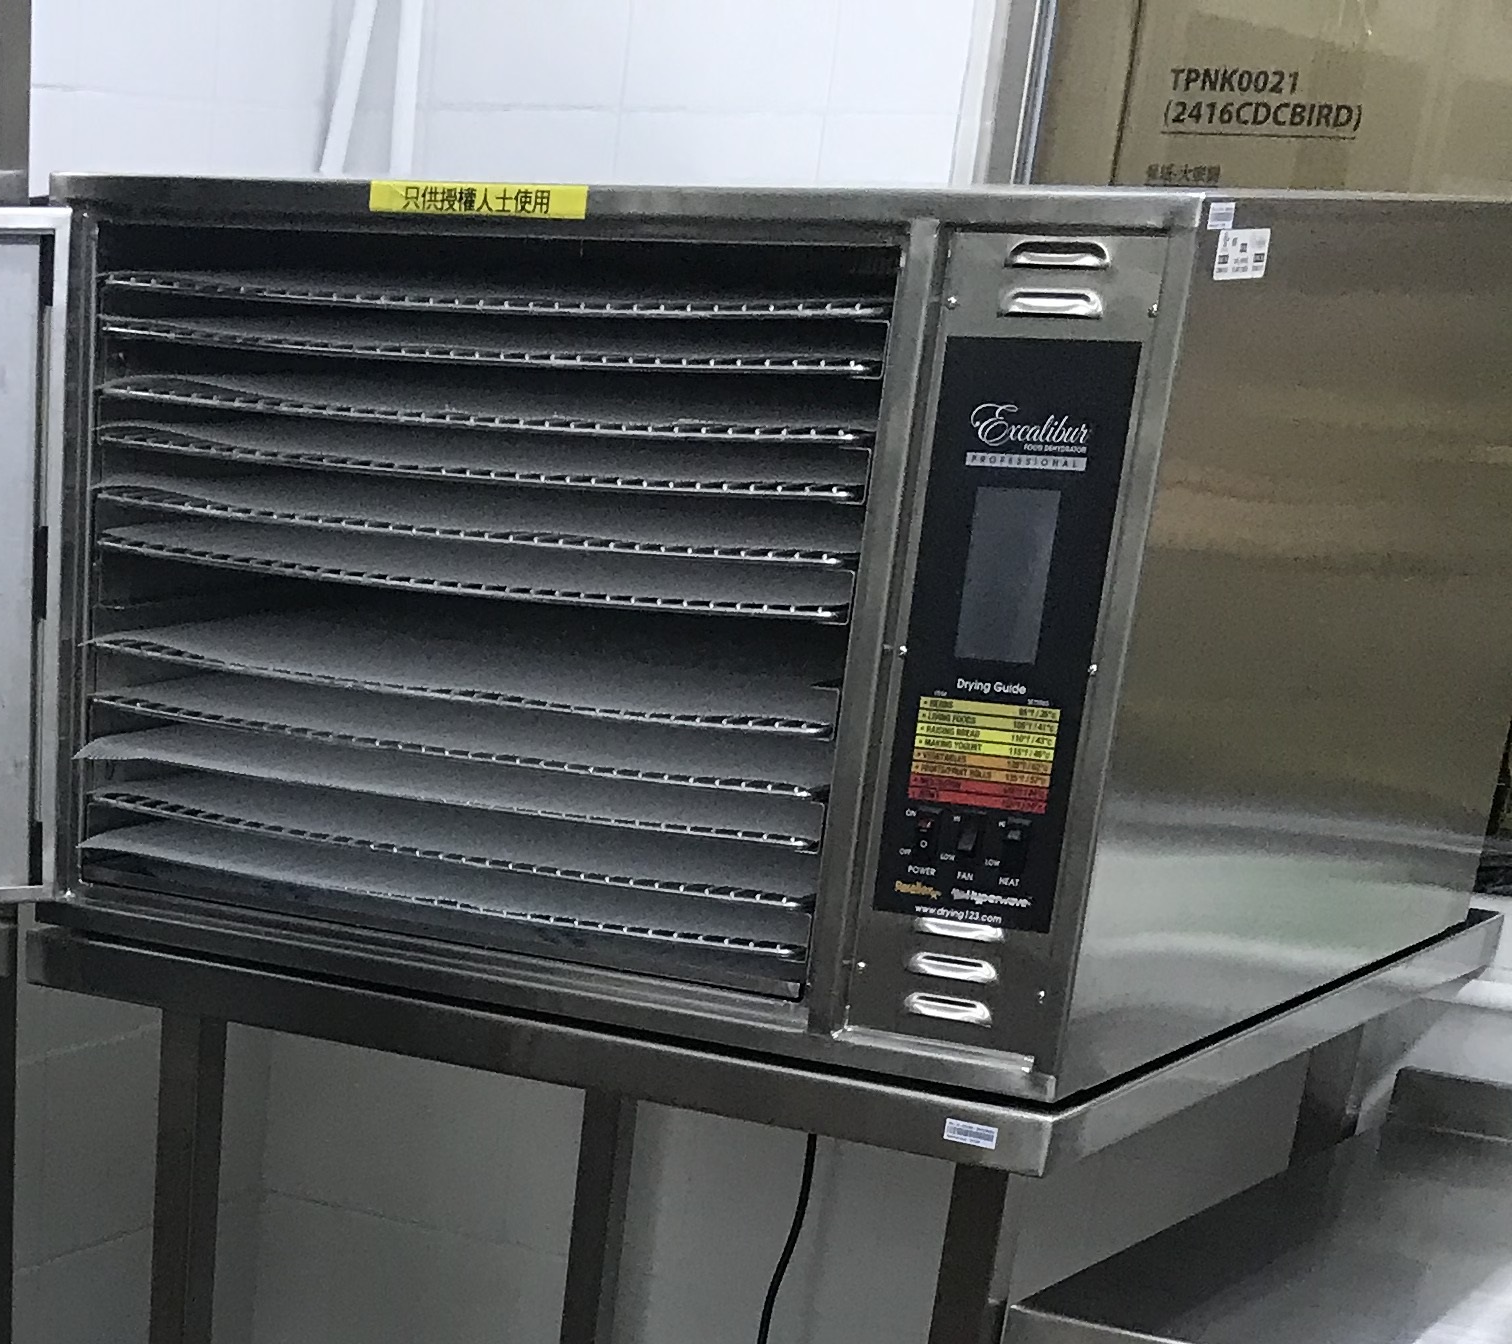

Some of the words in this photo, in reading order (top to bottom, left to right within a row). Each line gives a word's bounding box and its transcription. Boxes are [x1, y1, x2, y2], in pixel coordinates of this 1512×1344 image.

[1171, 68, 1299, 94] TPNK0021
[1164, 100, 1362, 131] (2416CDCBIRD)
[403, 186, 551, 214] 只供授權人士使用
[971, 403, 1088, 446] Excalibur
[971, 455, 1078, 468] PROFESSIONAL
[957, 678, 991, 693] Drying
[994, 682, 1027, 695] Guide
[908, 865, 936, 876] POWER
[957, 871, 974, 880] FAN
[999, 877, 1019, 887] HEAT
[915, 904, 1002, 924] www.drying123.com
